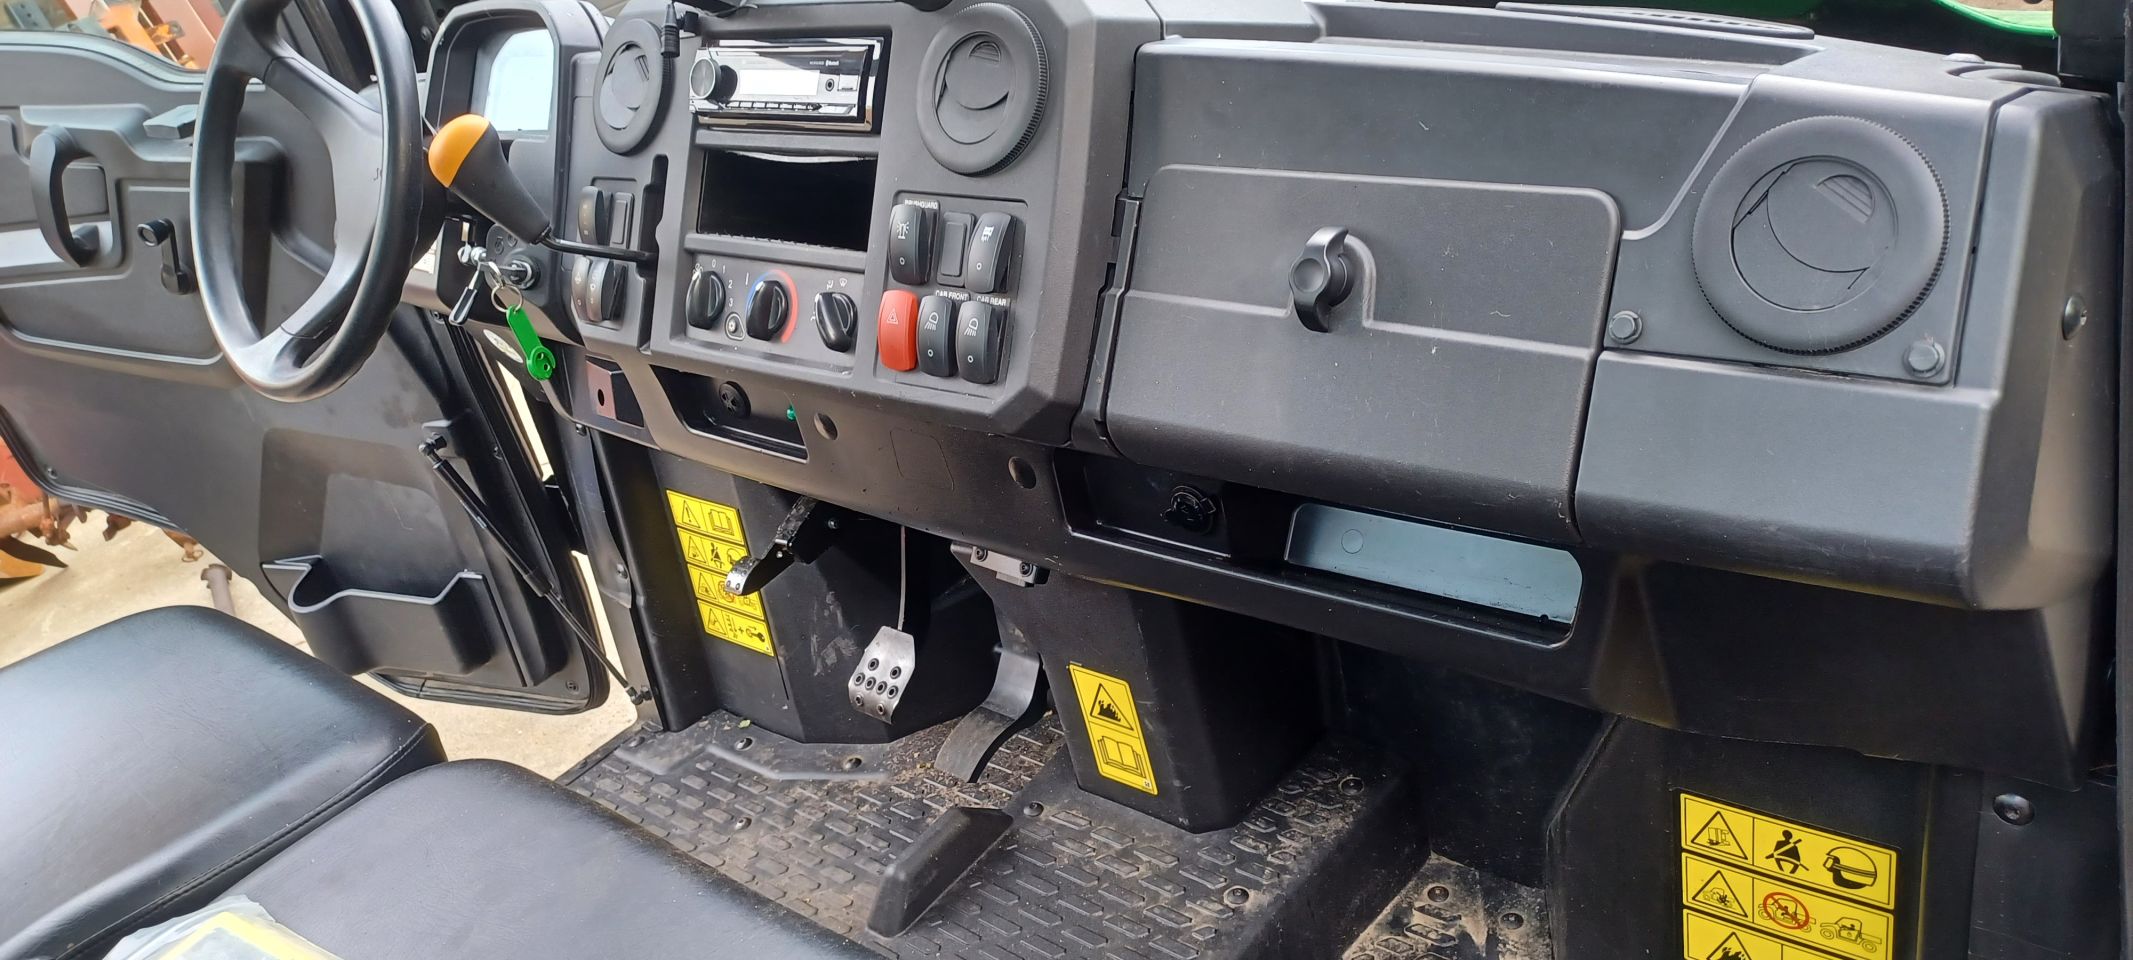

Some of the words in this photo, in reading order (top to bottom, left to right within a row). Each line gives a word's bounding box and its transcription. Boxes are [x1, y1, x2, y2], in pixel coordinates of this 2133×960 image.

[728, 279, 733, 288] 2
[948, 291, 969, 301] FRONT
[728, 298, 733, 307] 3
[989, 297, 1007, 306] REAR
